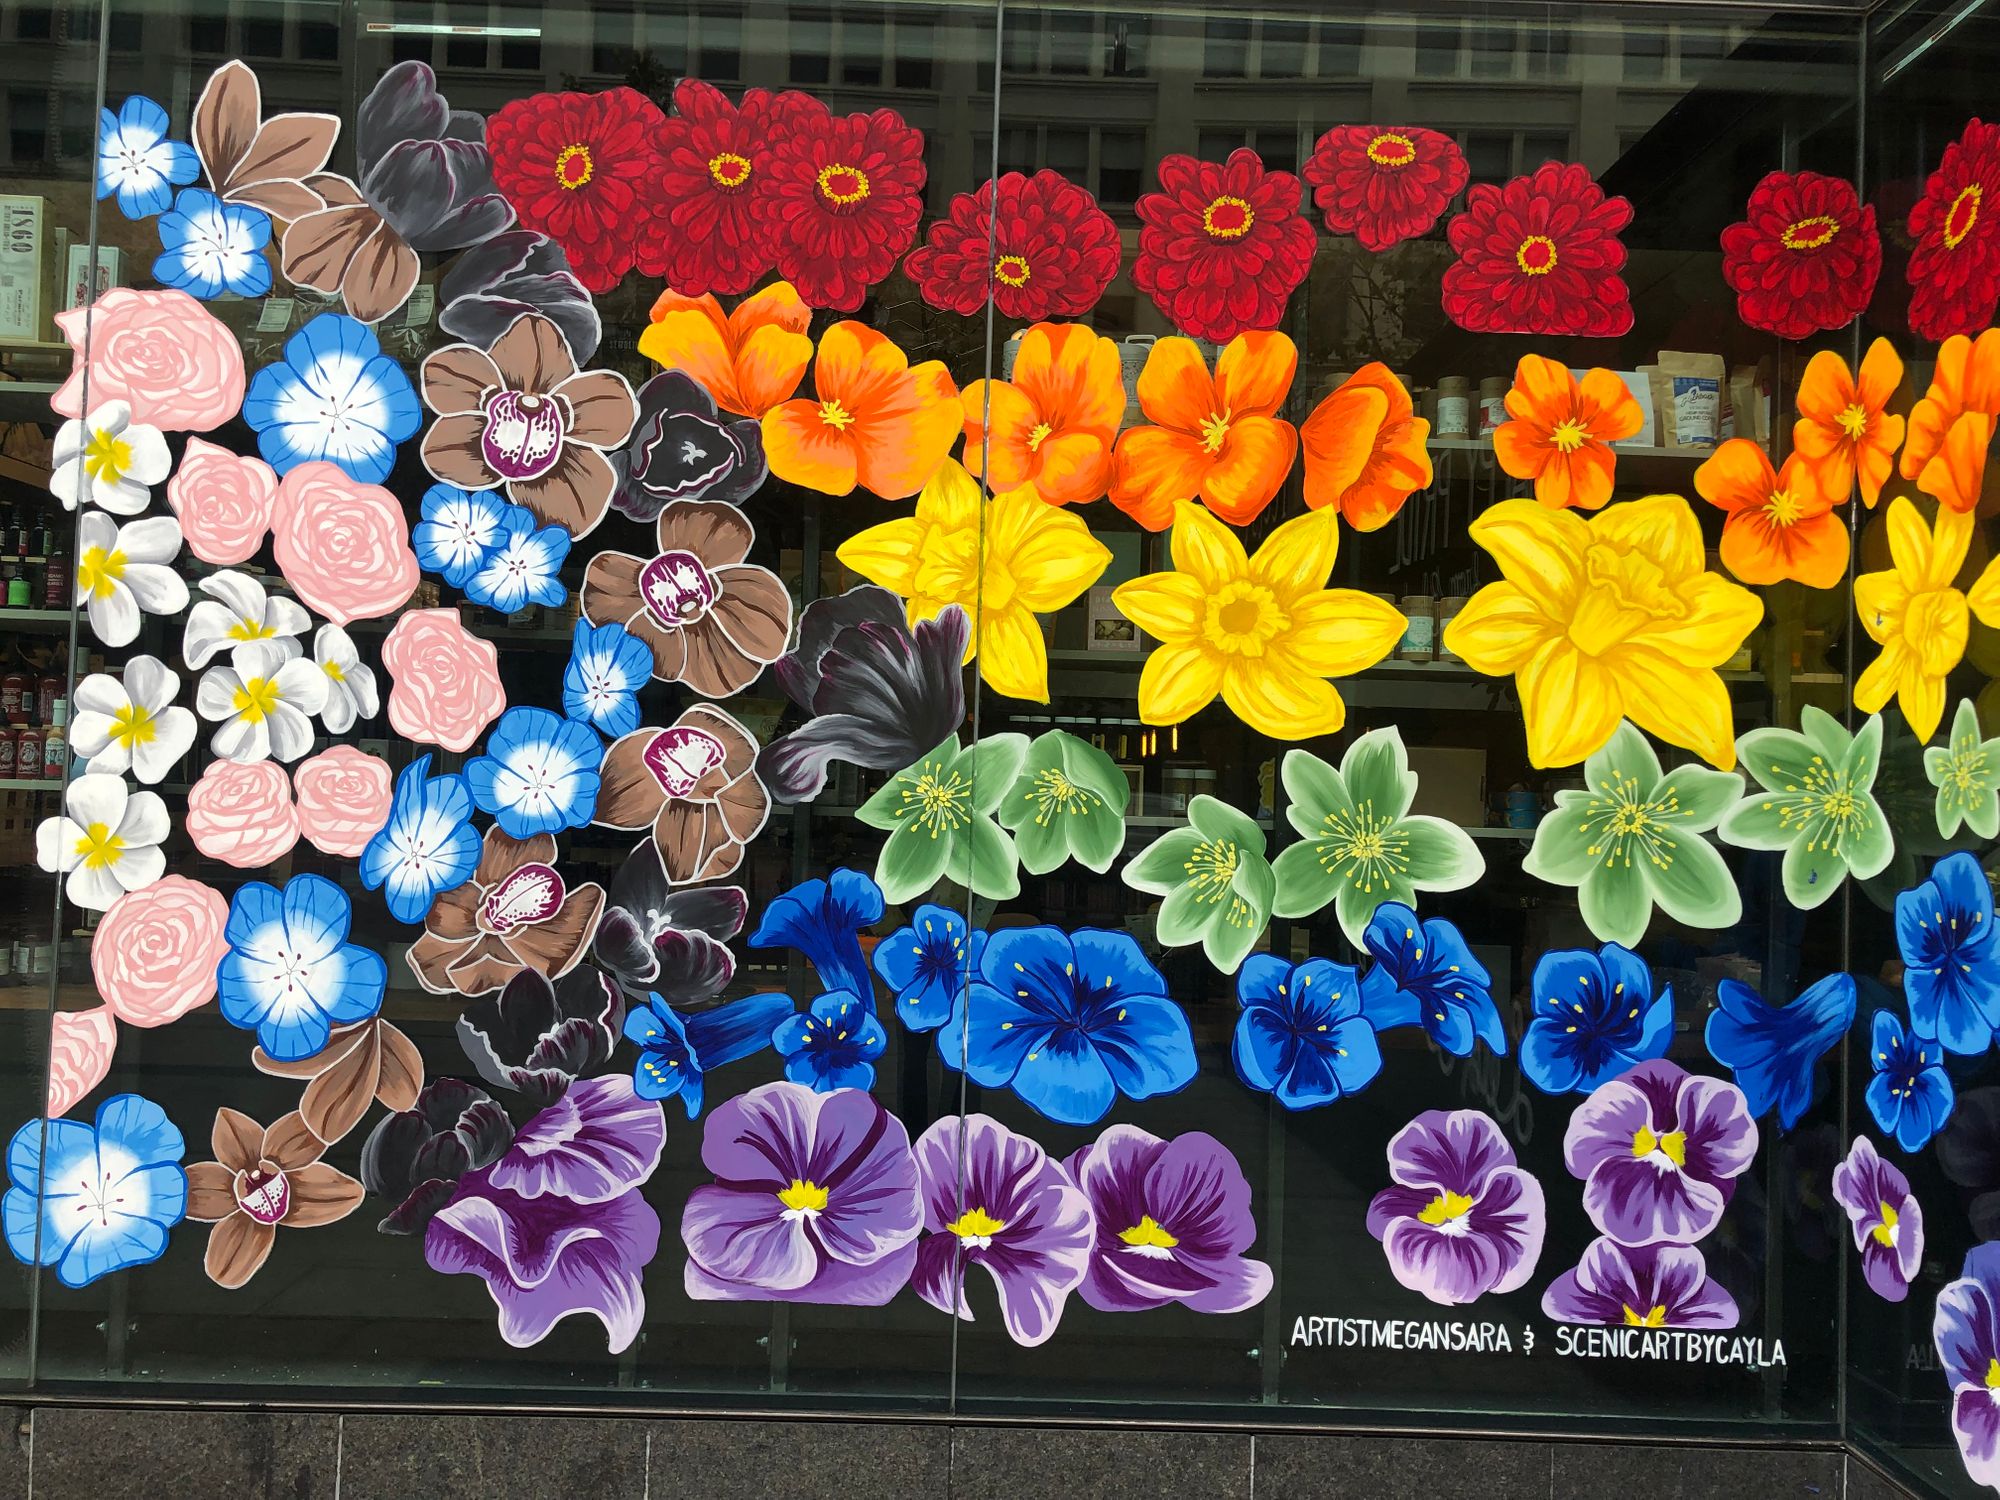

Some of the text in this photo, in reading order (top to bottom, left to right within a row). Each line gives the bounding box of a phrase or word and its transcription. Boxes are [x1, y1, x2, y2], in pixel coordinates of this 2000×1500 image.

[11, 209, 34, 252] 1860
[1291, 1316, 1513, 1353] ARTISTMEGANSARA
[1555, 1326, 1787, 1367] SCENICARTBYCAYLA
